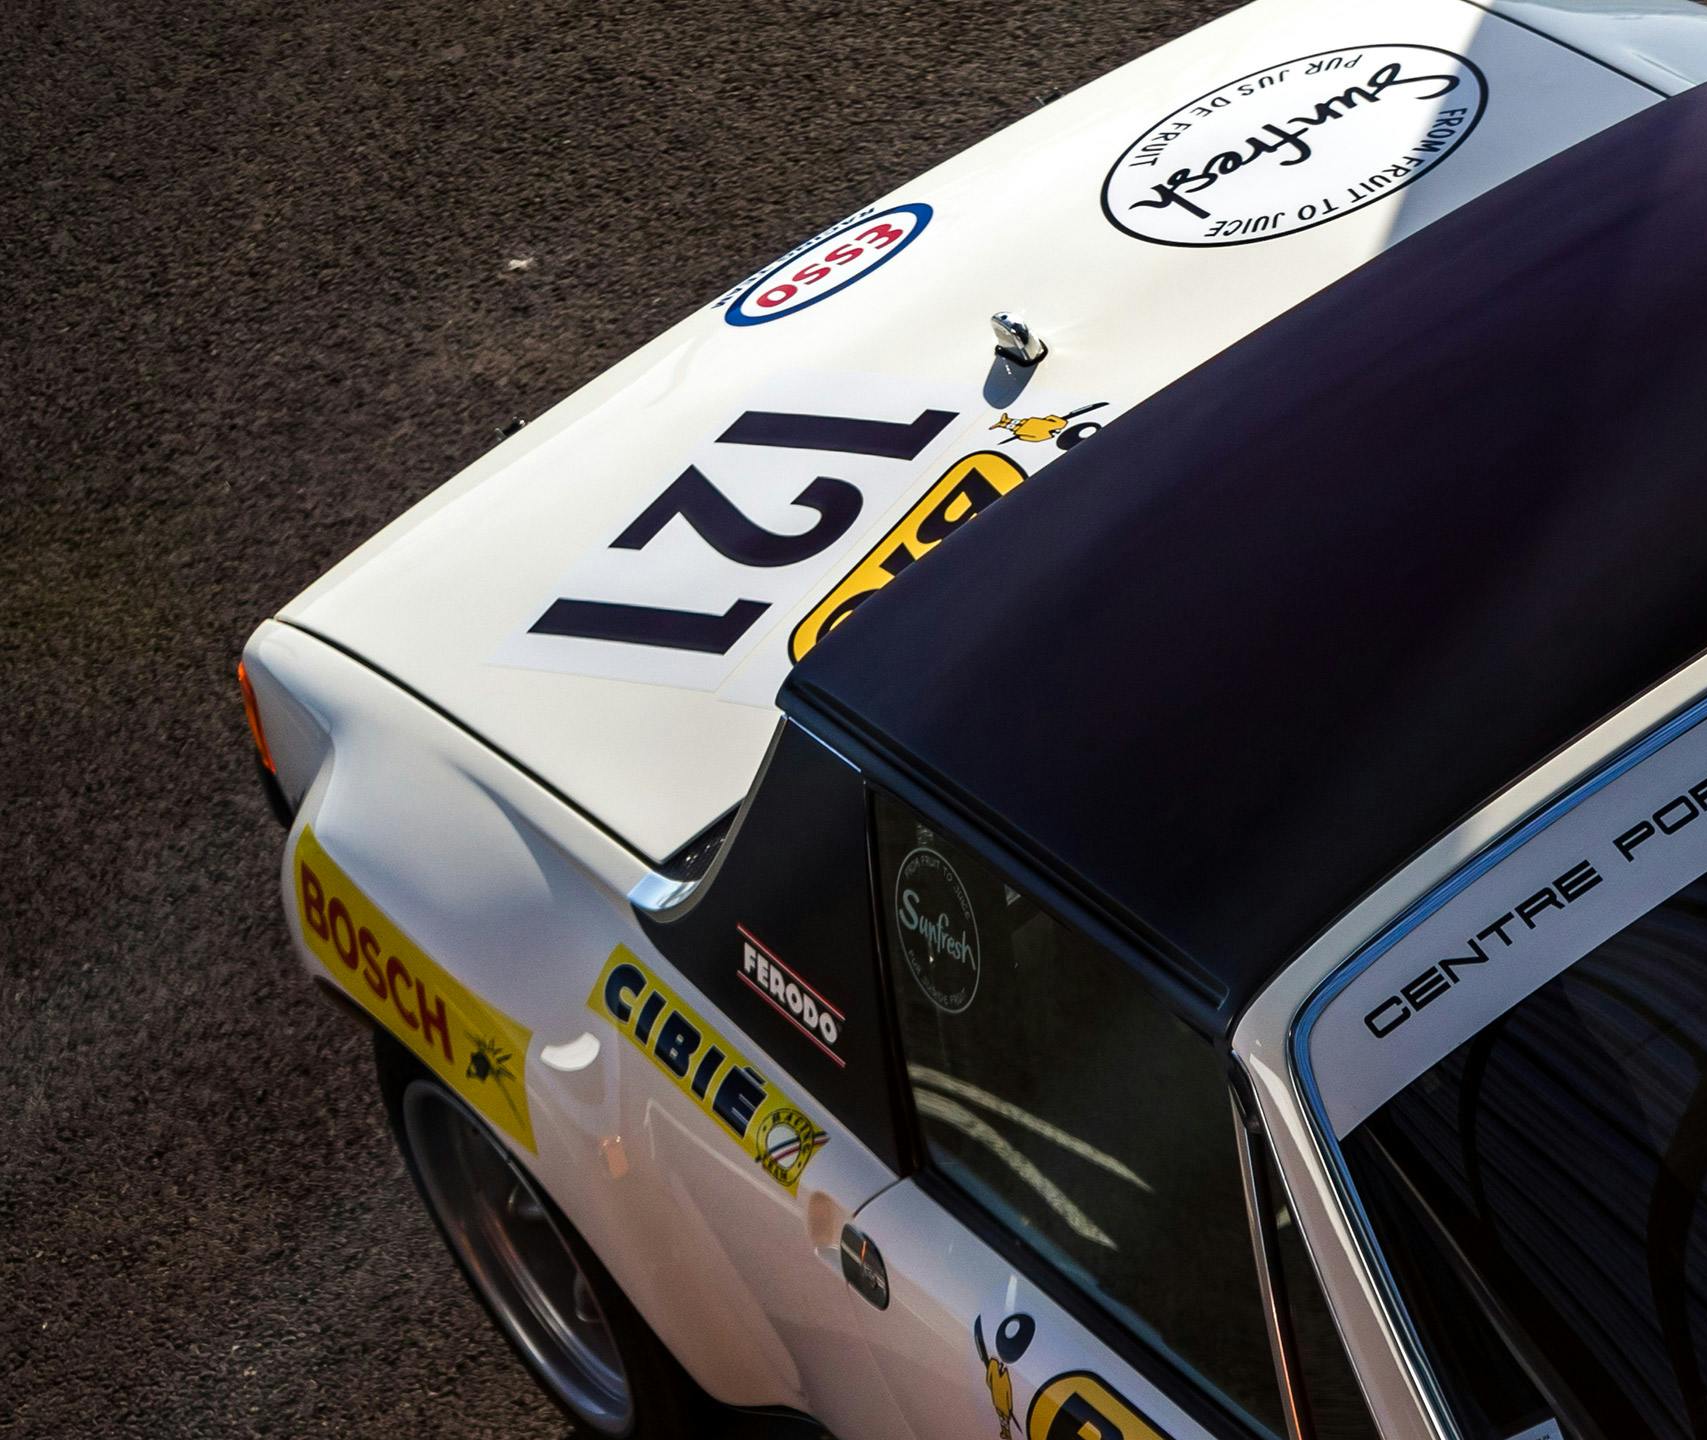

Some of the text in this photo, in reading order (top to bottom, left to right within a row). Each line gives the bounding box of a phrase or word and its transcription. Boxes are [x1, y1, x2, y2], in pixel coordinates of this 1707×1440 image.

[1129, 53, 1363, 169] PUR JUS DE FRUIT
[1130, 62, 1460, 219] Sunfresh
[1204, 107, 1468, 238] FROM FRUIT TO JUICE
[526, 409, 958, 655] 121
[300, 859, 454, 1063] BOSCH
[743, 943, 839, 1046] FERODO
[899, 889, 976, 970] Sunfresh
[1363, 859, 1603, 1038] CENTRE
[604, 962, 767, 1139] CIBIÉ
